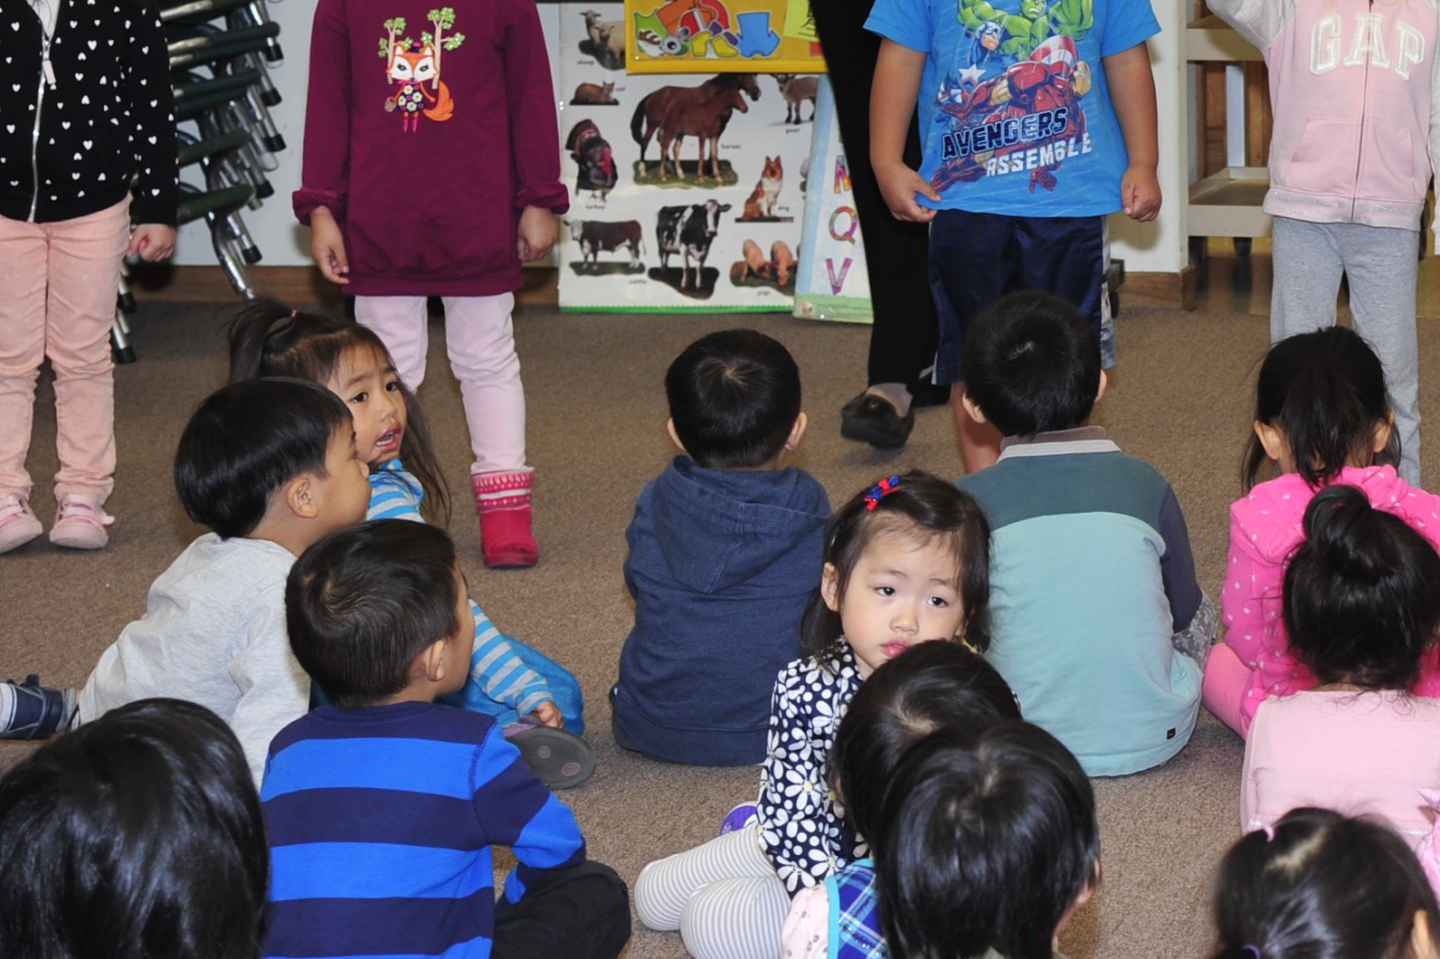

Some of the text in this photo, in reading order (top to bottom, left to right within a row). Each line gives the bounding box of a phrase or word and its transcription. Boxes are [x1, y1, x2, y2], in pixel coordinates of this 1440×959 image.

[1310, 12, 1426, 81] GAP
[942, 107, 1069, 160] AVENGERS
[987, 133, 1093, 177] ASSEMBLE
[829, 205, 858, 245] Q
[825, 257, 854, 295] V
